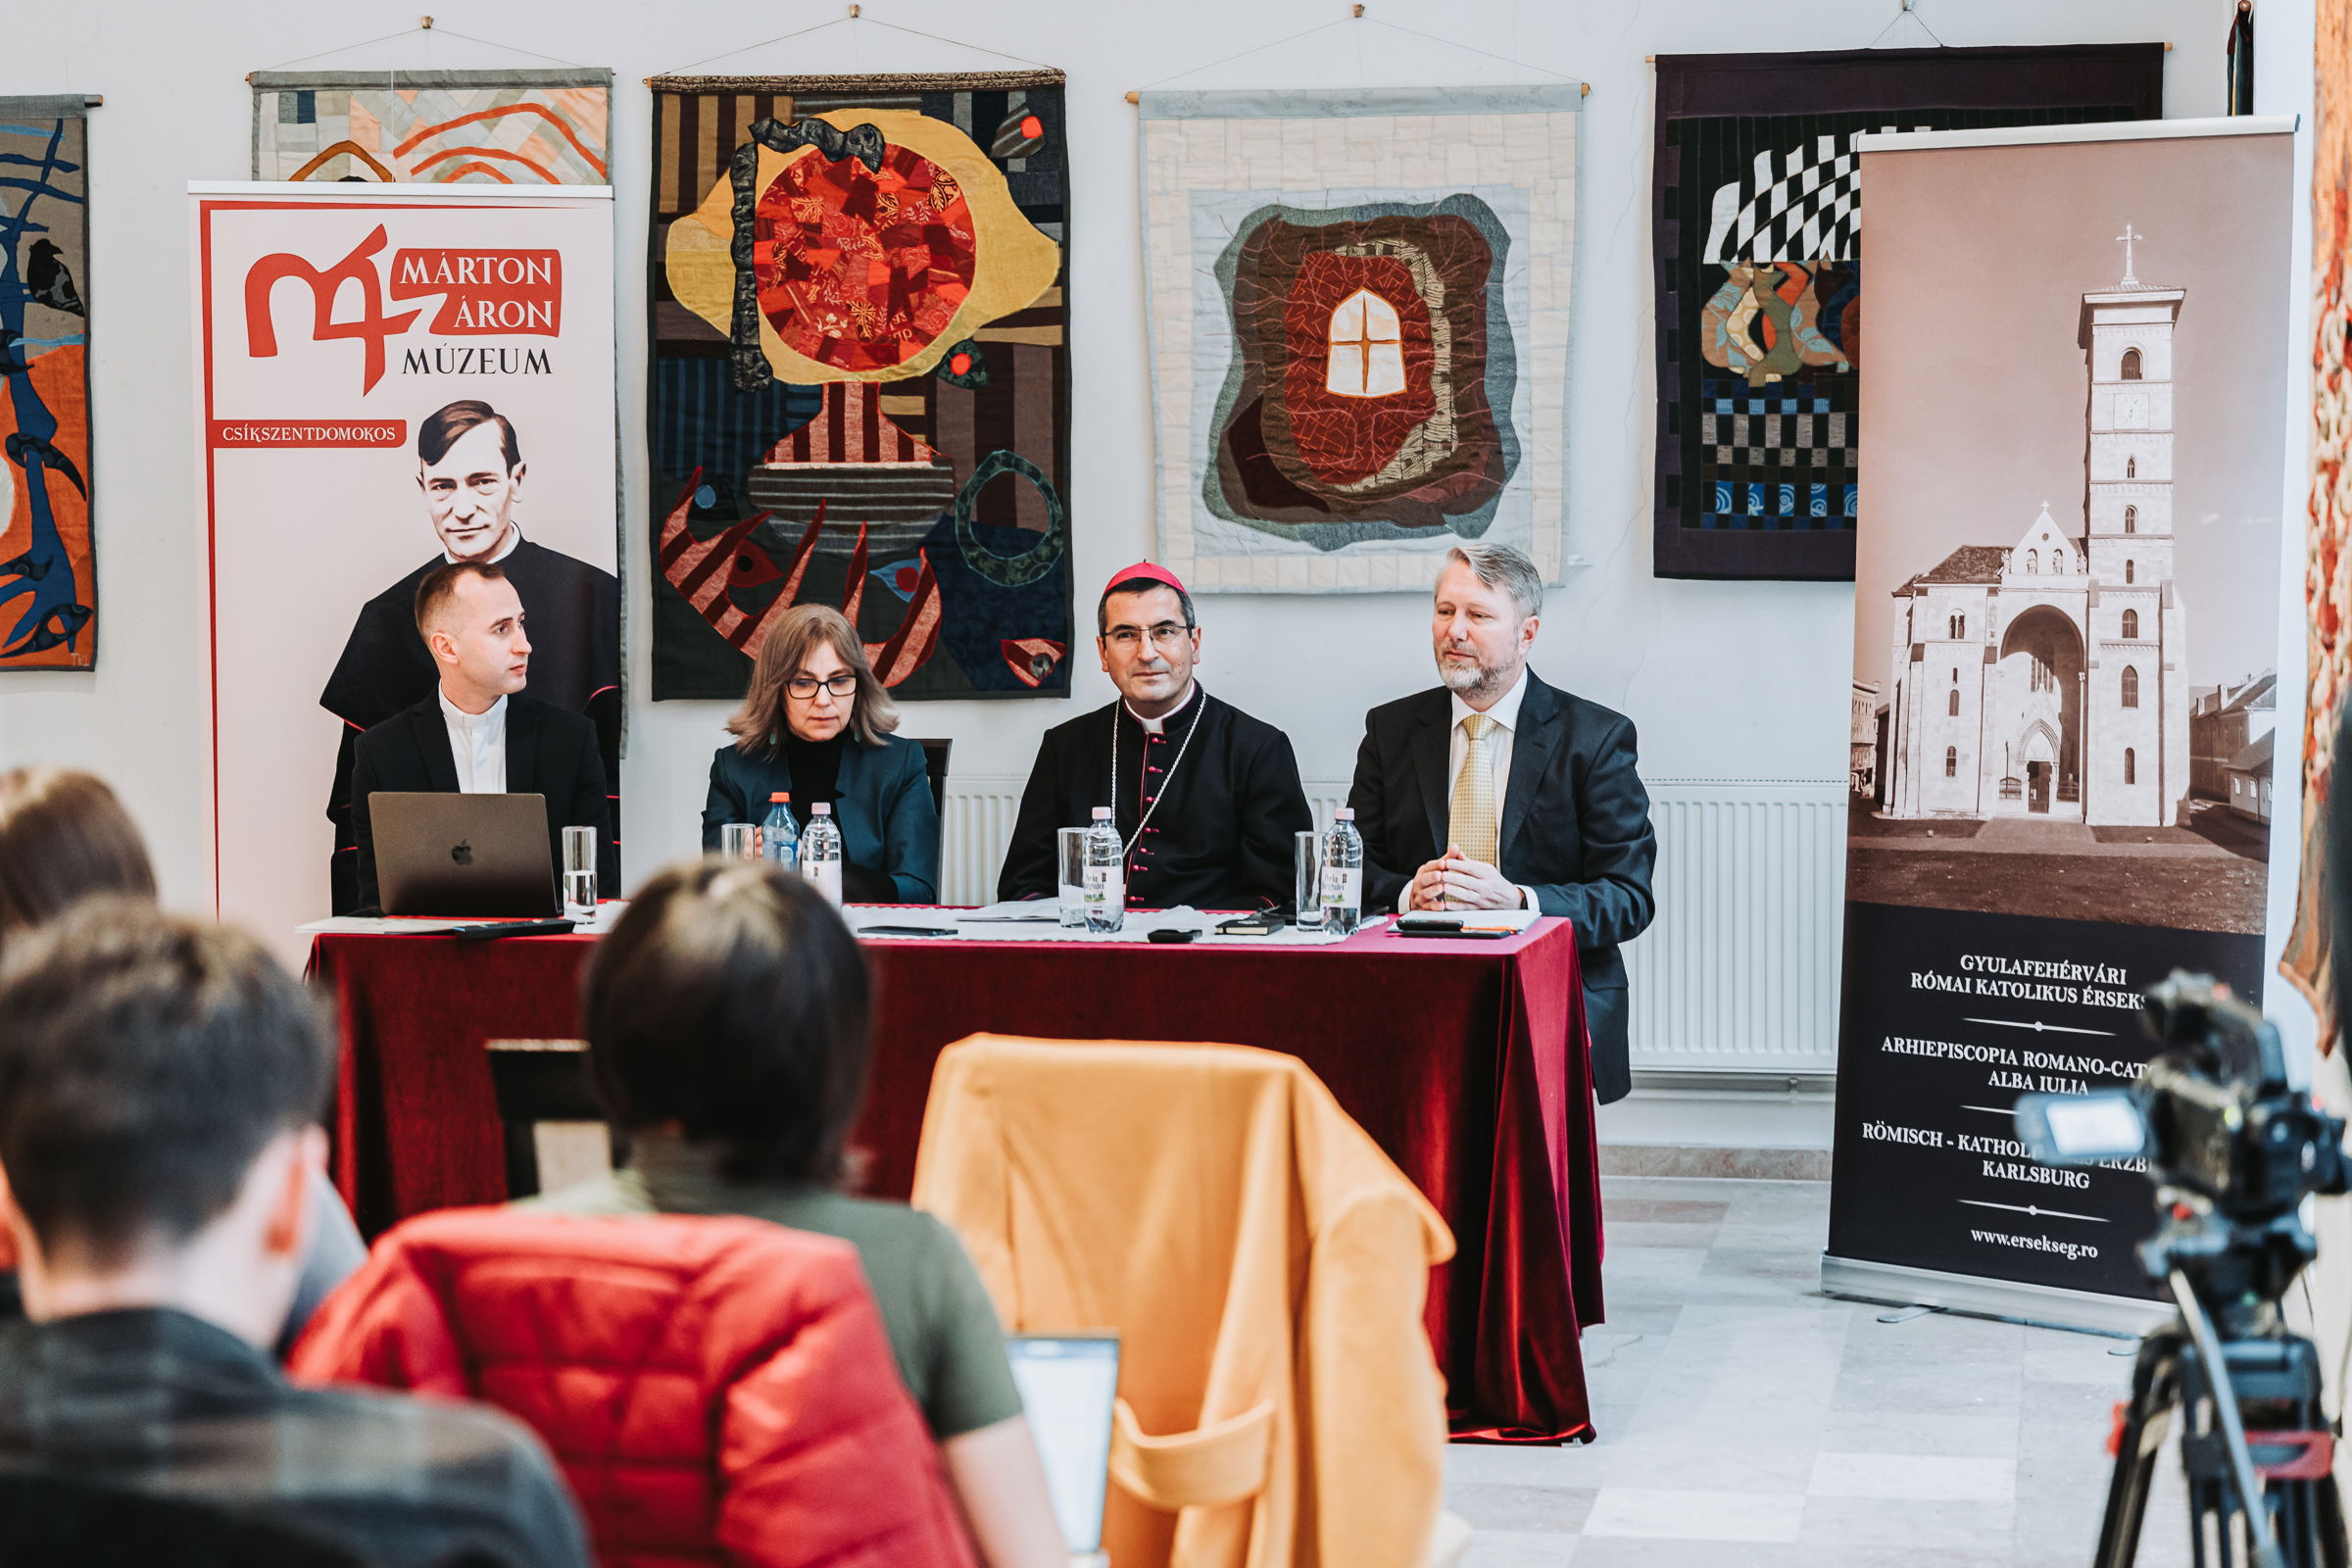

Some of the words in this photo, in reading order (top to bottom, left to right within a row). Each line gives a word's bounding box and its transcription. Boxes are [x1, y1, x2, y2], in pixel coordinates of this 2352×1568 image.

[399, 251, 552, 285] MÁRTON
[453, 295, 552, 329] ÁRON
[401, 343, 554, 375] MÚZEUM
[221, 422, 396, 442] CSÍKSZENTDOMOKOS
[1960, 955, 2128, 986] GYULAFEHÉRVÁRI
[1910, 970, 1972, 995] RÓMAI
[1975, 978, 2078, 1004] KATOLIKUS
[1881, 1036, 2019, 1066] ARHIEPISCOPIA
[1987, 1070, 2034, 1092] ALBA
[2038, 1075, 2089, 1097] IULIA
[1862, 1120, 1943, 1149] RÖMISCH
[1982, 1159, 2090, 1190] KARLSBURG
[1970, 1228, 2099, 1260] www.ersekseg.ro
